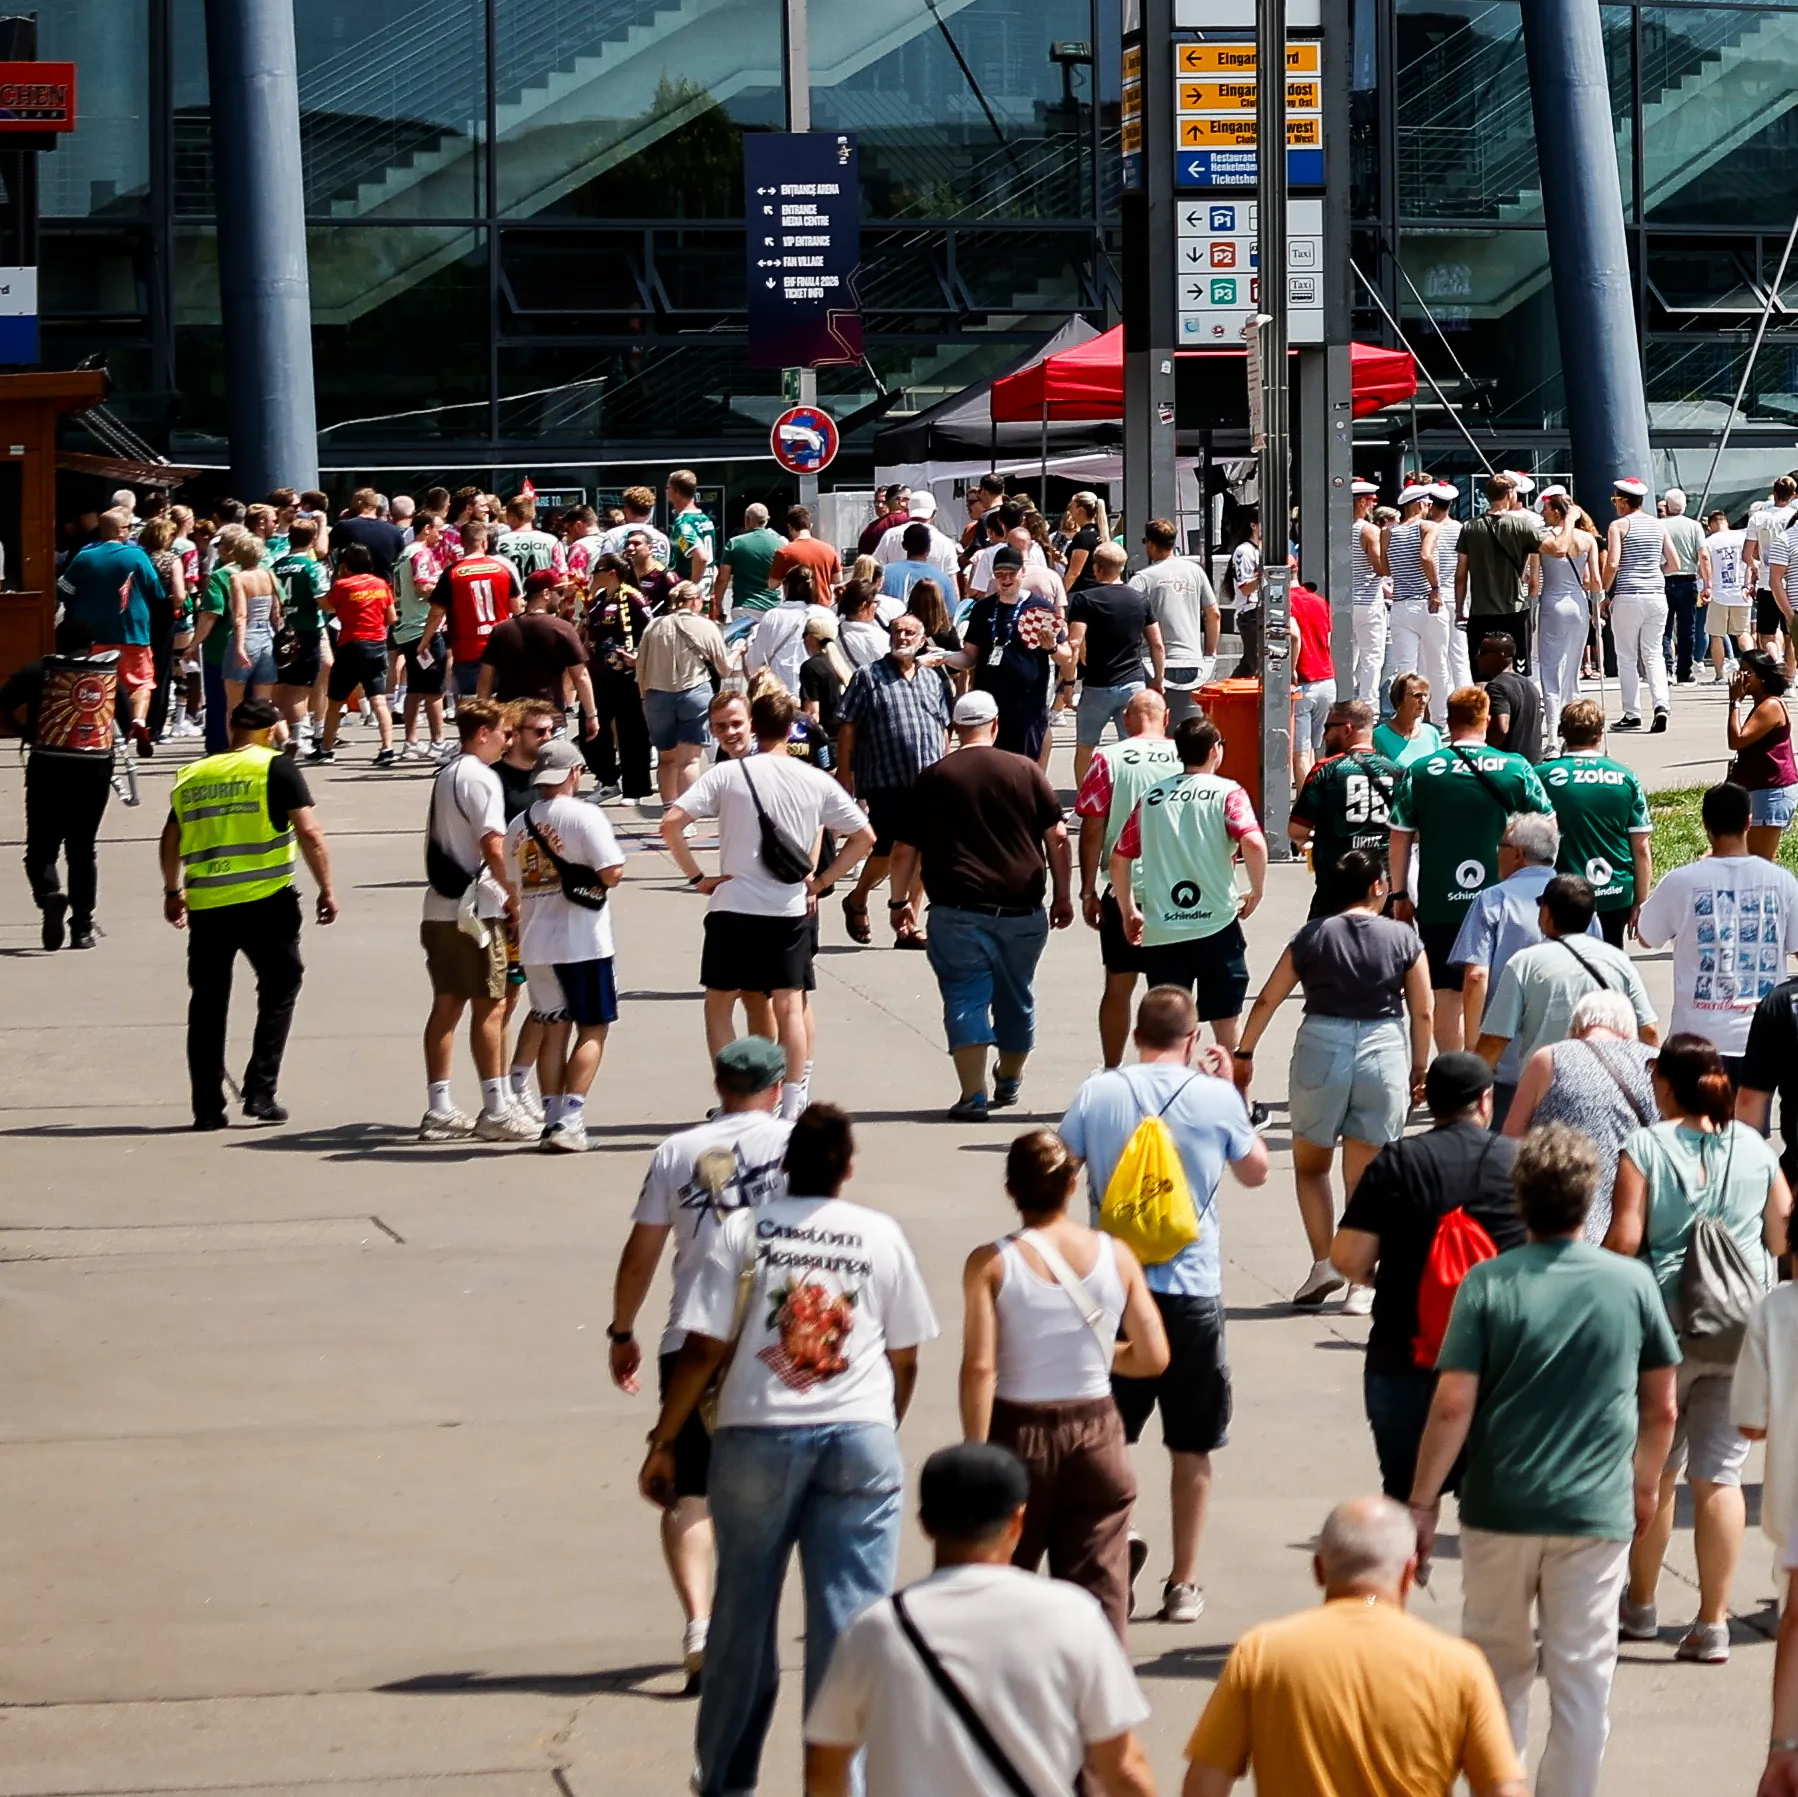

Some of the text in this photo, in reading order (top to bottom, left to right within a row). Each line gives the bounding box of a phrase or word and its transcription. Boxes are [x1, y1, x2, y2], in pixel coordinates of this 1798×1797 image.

[781, 183, 840, 197] ENTRANCE ARENA
[781, 204, 818, 216] ENTRANCE
[804, 215, 830, 227] CENTRE
[1213, 216, 1232, 228] P1
[782, 235, 831, 247] VIP ENTRANCE
[1213, 252, 1233, 264] P2
[1292, 249, 1312, 259] Taxi
[783, 255, 824, 267] FAN VILLAGE
[1292, 280, 1312, 290] Taxi
[1214, 289, 1234, 301] P3
[514, 541, 547, 551] zolar
[470, 579, 496, 623] 11
[1572, 767, 1626, 787] zolar
[182, 779, 252, 803] SECURITY
[1170, 786, 1222, 804] zolar
[1165, 909, 1214, 923] Schindler
[757, 1219, 863, 1248] Custom
